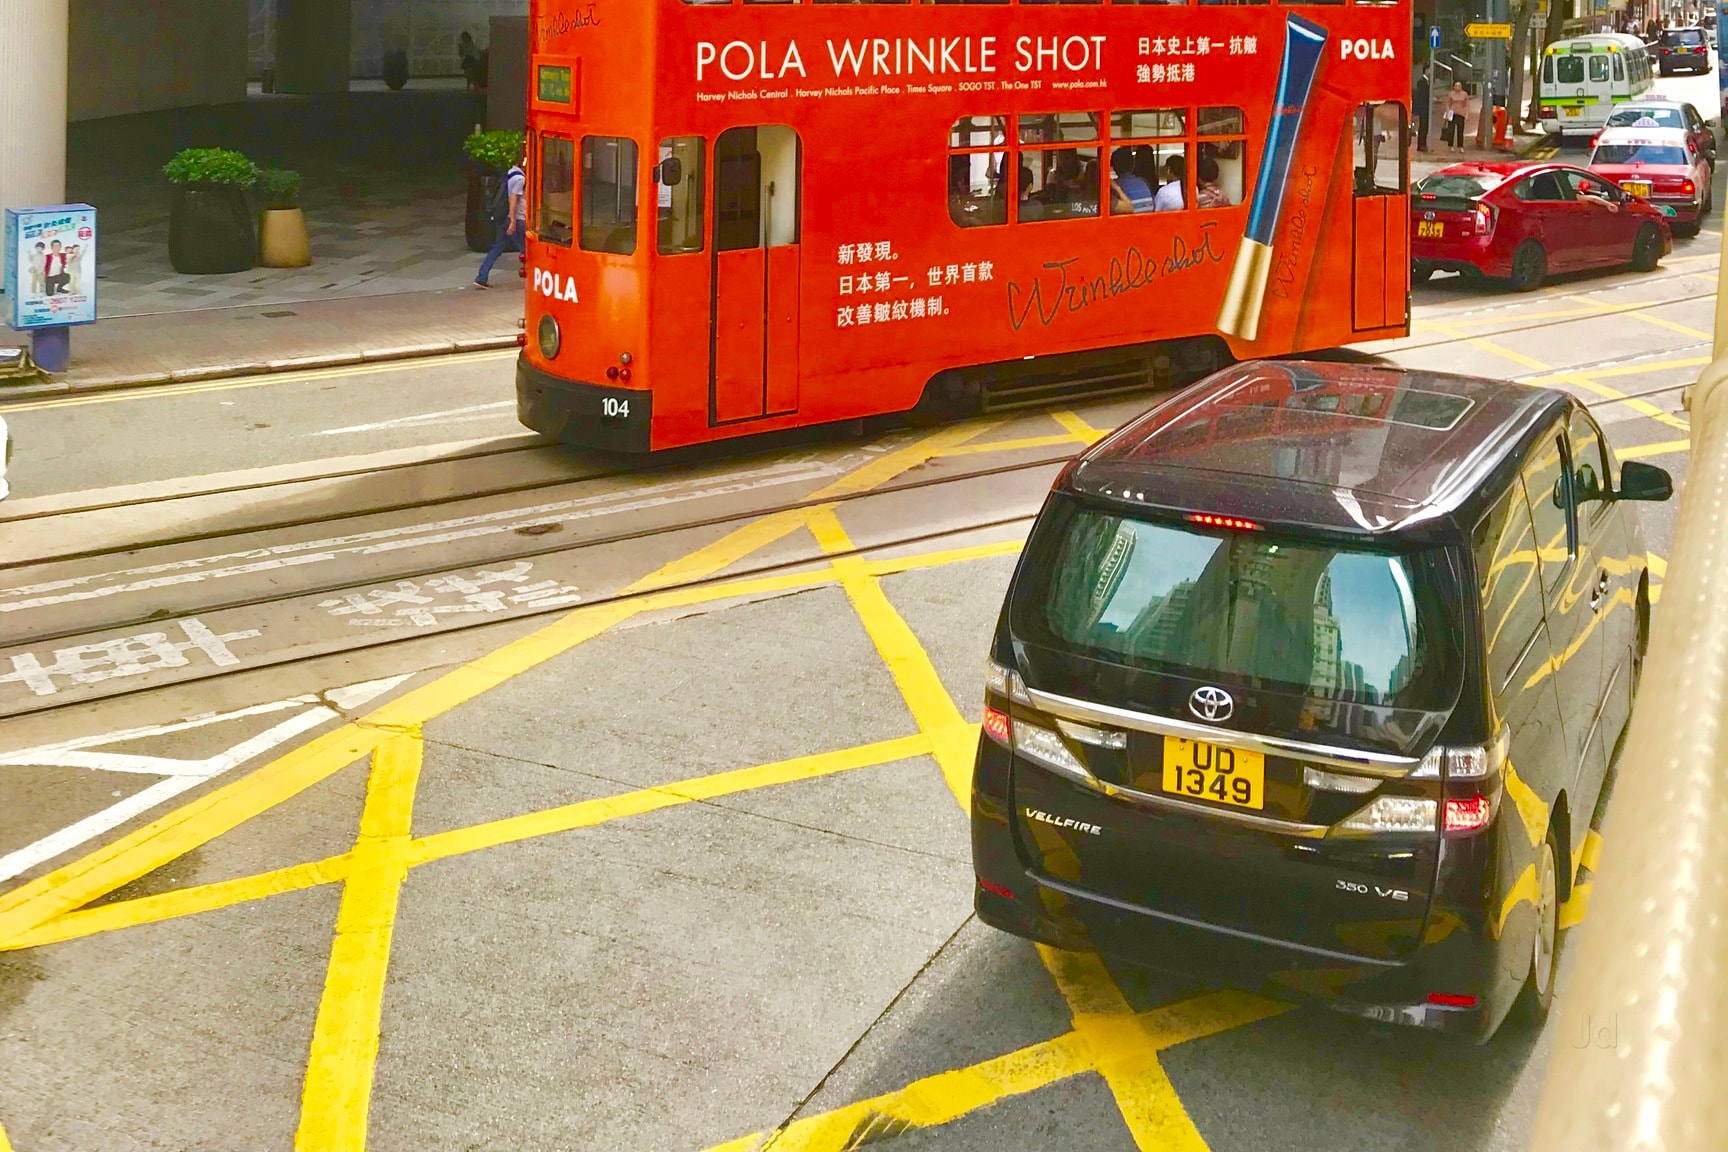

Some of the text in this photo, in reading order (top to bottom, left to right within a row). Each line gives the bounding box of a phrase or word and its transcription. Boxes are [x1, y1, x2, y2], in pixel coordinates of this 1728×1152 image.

[697, 35, 1107, 81] POLA WRINKLE SHOT
[1340, 39, 1395, 60] POLA
[1136, 64, 1195, 83] 強勢抵港
[697, 78, 1107, 103] Harvey Nichols Central Harvey Nichols Pacific Place Times Square SOGO TST The One TST www.pola.com.hk
[533, 267, 579, 304] POLA
[602, 397, 630, 418] 104
[1193, 745, 1235, 774] UD
[1175, 765, 1251, 805] 1349
[1025, 807, 1102, 836] VELLFIRE
[1335, 879, 1368, 895] 350
